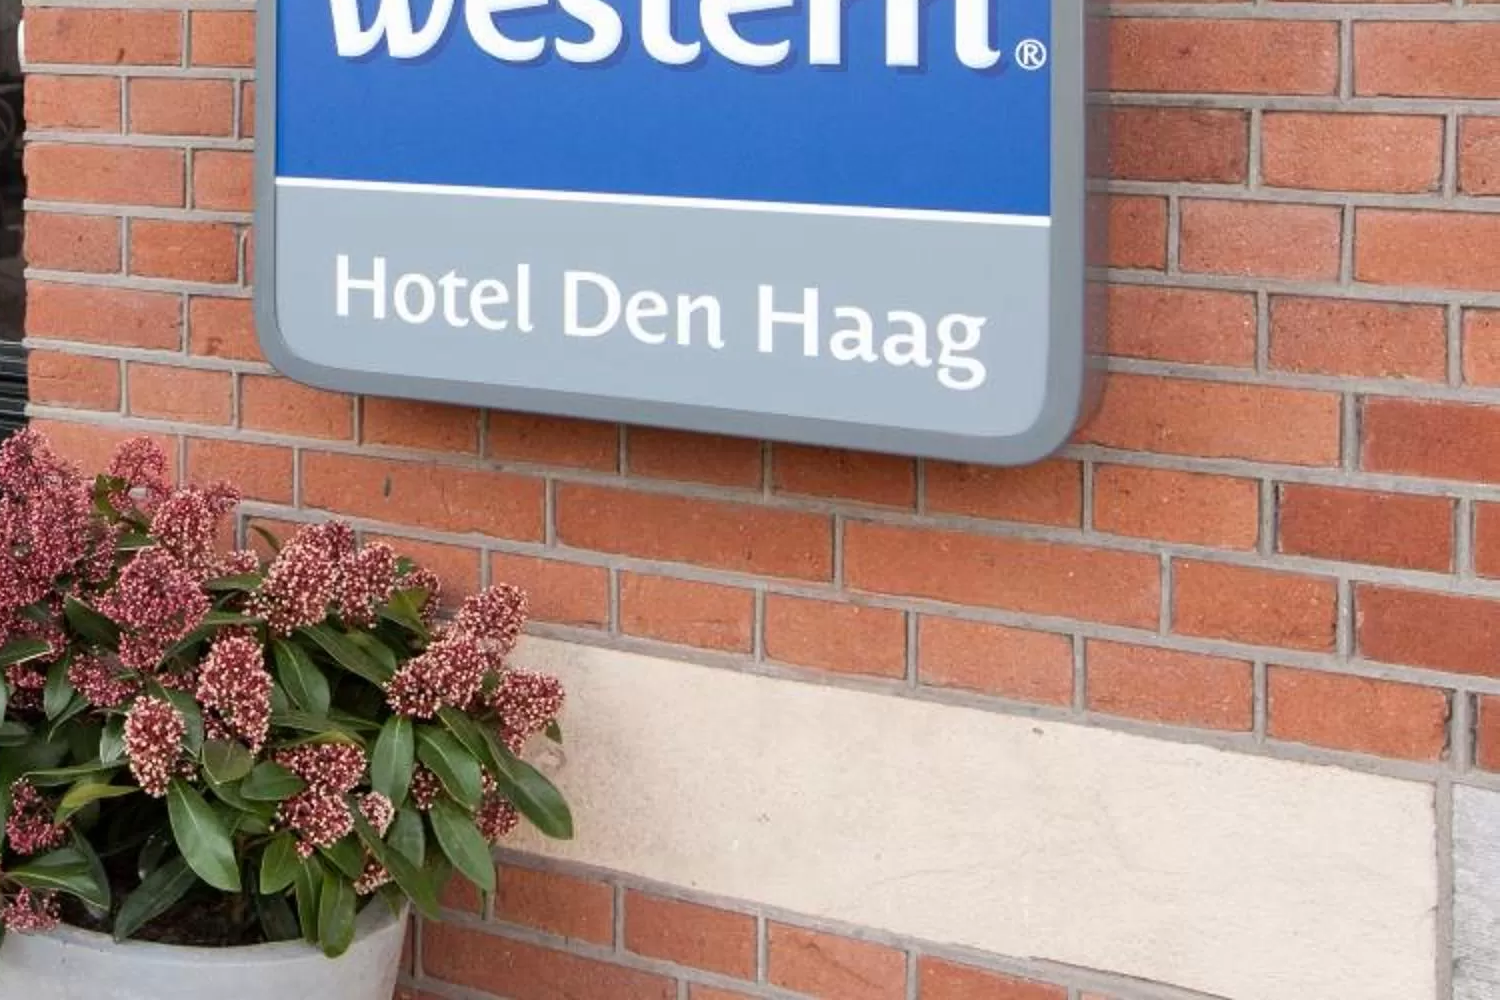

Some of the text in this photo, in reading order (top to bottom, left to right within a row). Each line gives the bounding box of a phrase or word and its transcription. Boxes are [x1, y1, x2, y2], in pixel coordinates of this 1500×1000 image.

[335, 254, 988, 391] Hotel Den Haag
